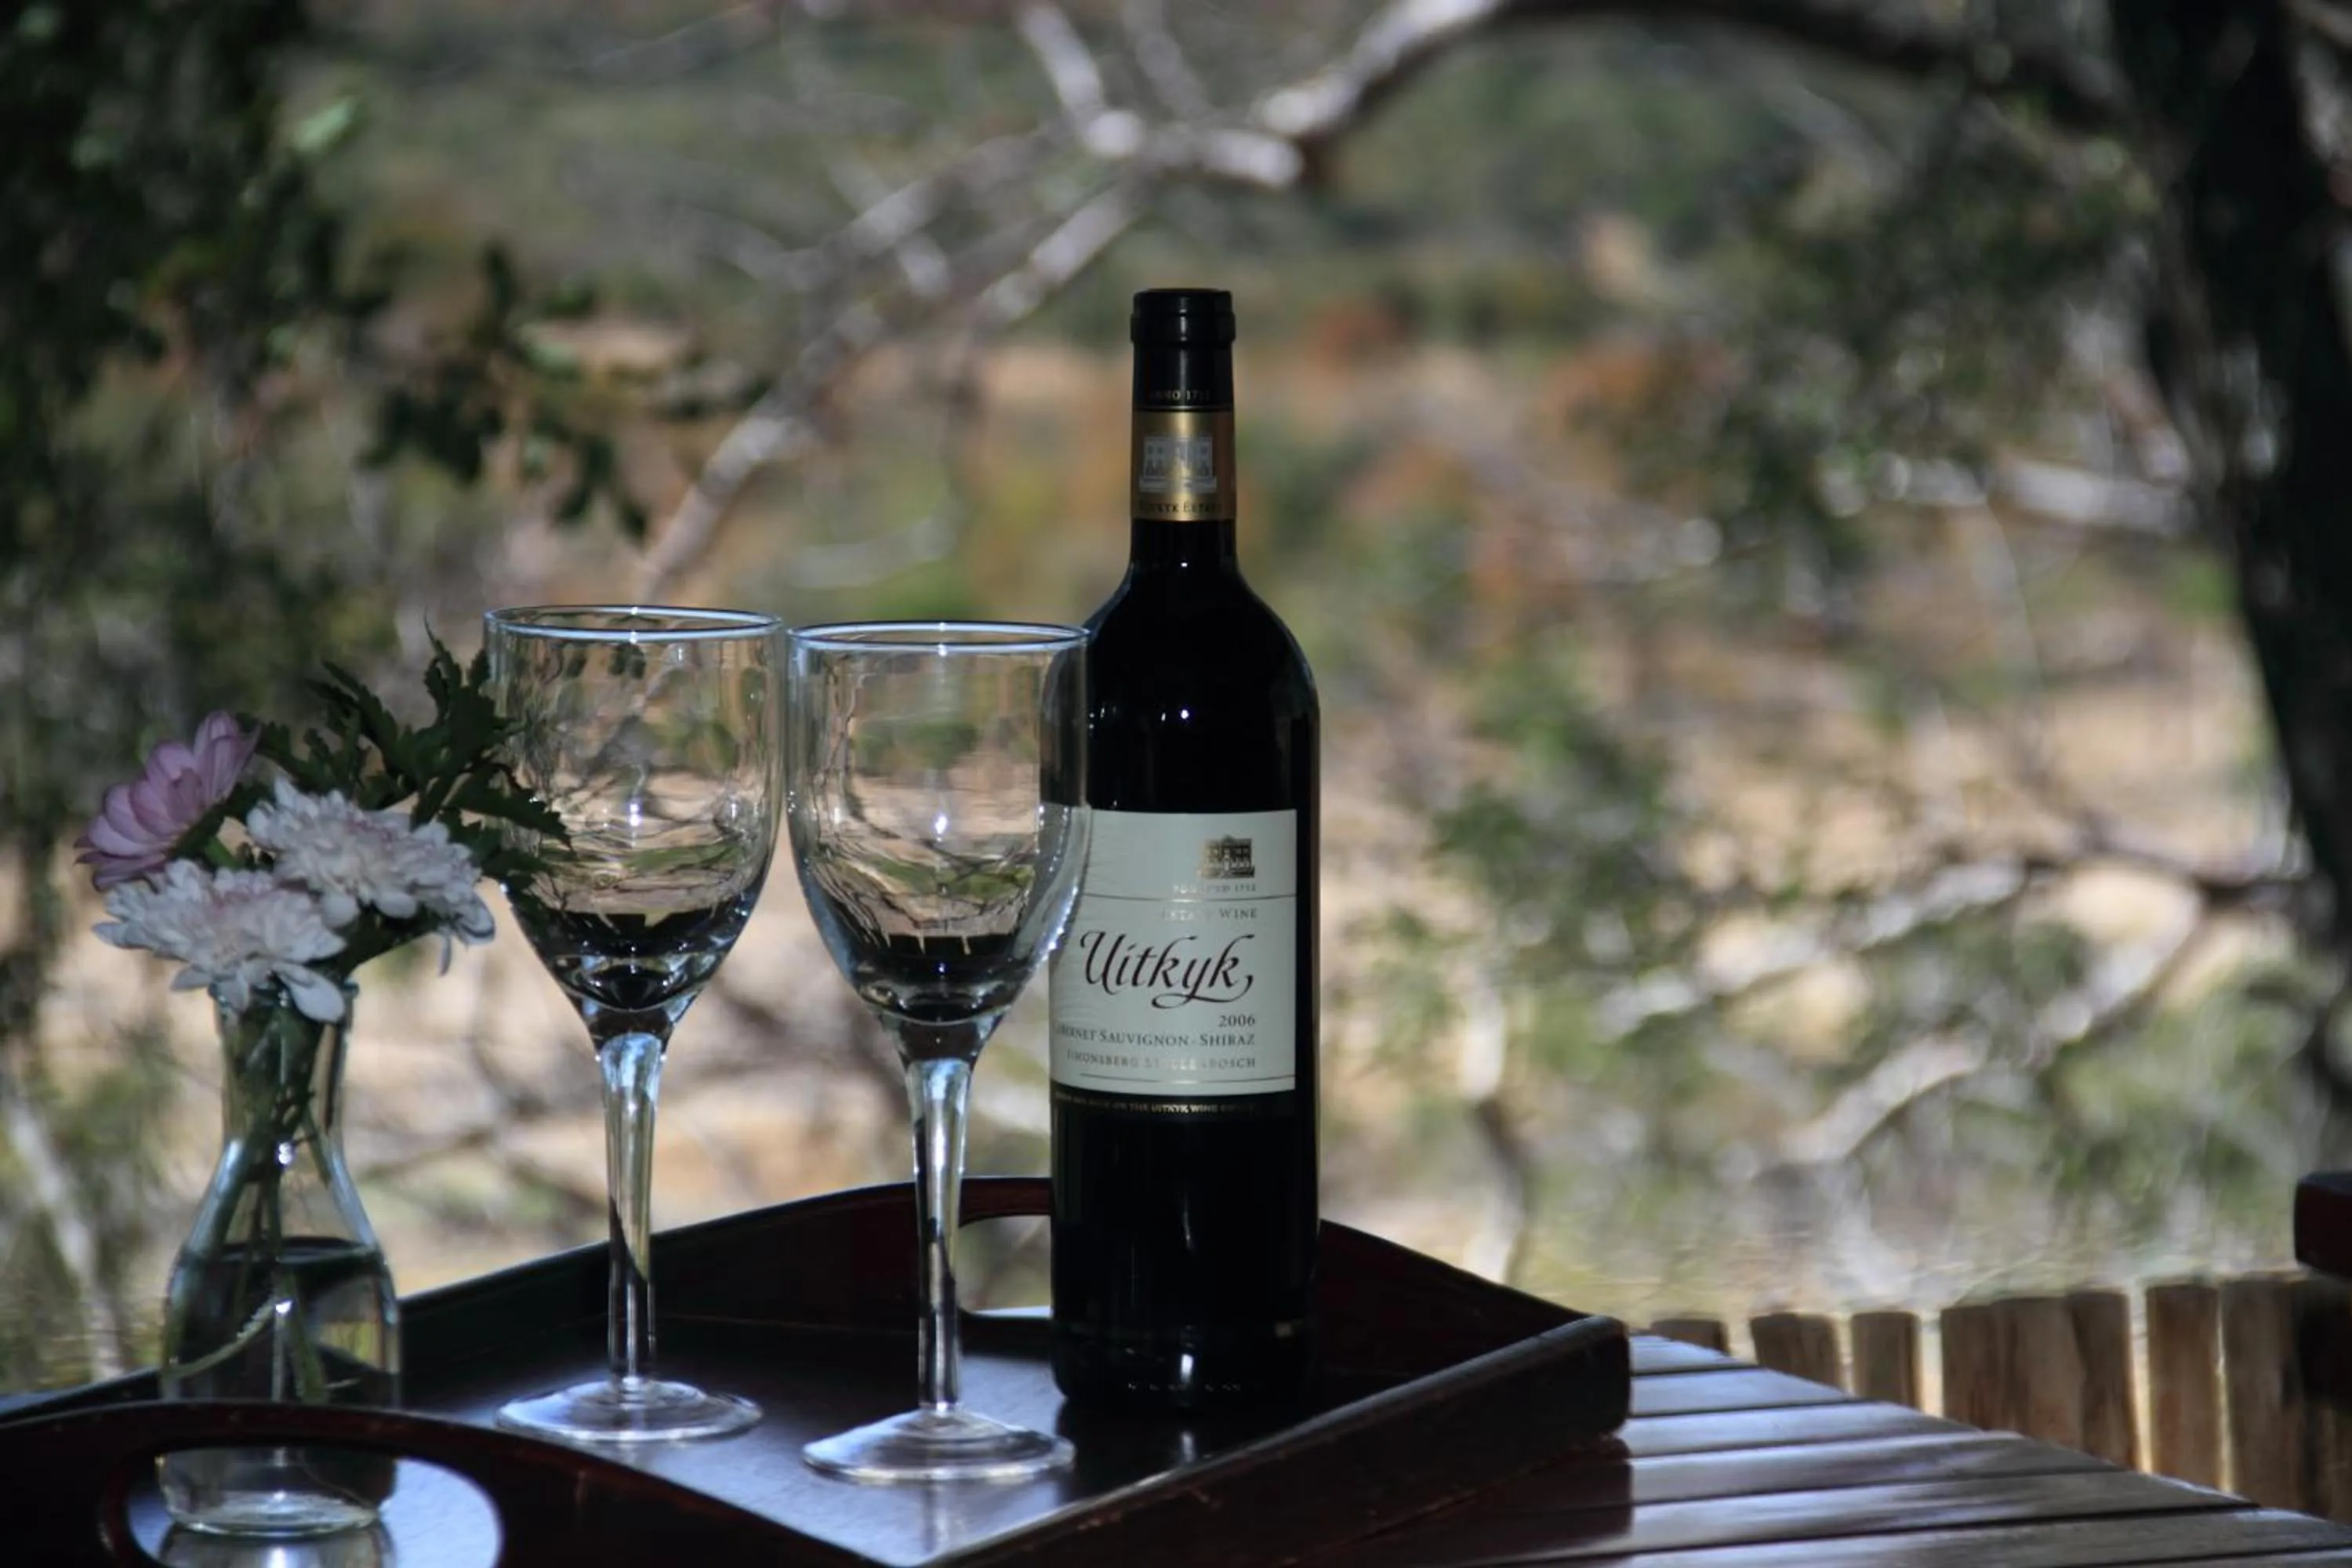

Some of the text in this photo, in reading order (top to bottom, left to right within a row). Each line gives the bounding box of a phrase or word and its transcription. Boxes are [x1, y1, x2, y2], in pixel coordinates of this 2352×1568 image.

[1173, 883, 1231, 895] FOUED
[1219, 907, 1258, 920] WINE
[1080, 930, 1255, 1009] Uitkyk
[1218, 1014, 1256, 1028] 2006
[1099, 1029, 1189, 1048] SAUVIGNON
[1200, 1033, 1255, 1047] SHIRAZ
